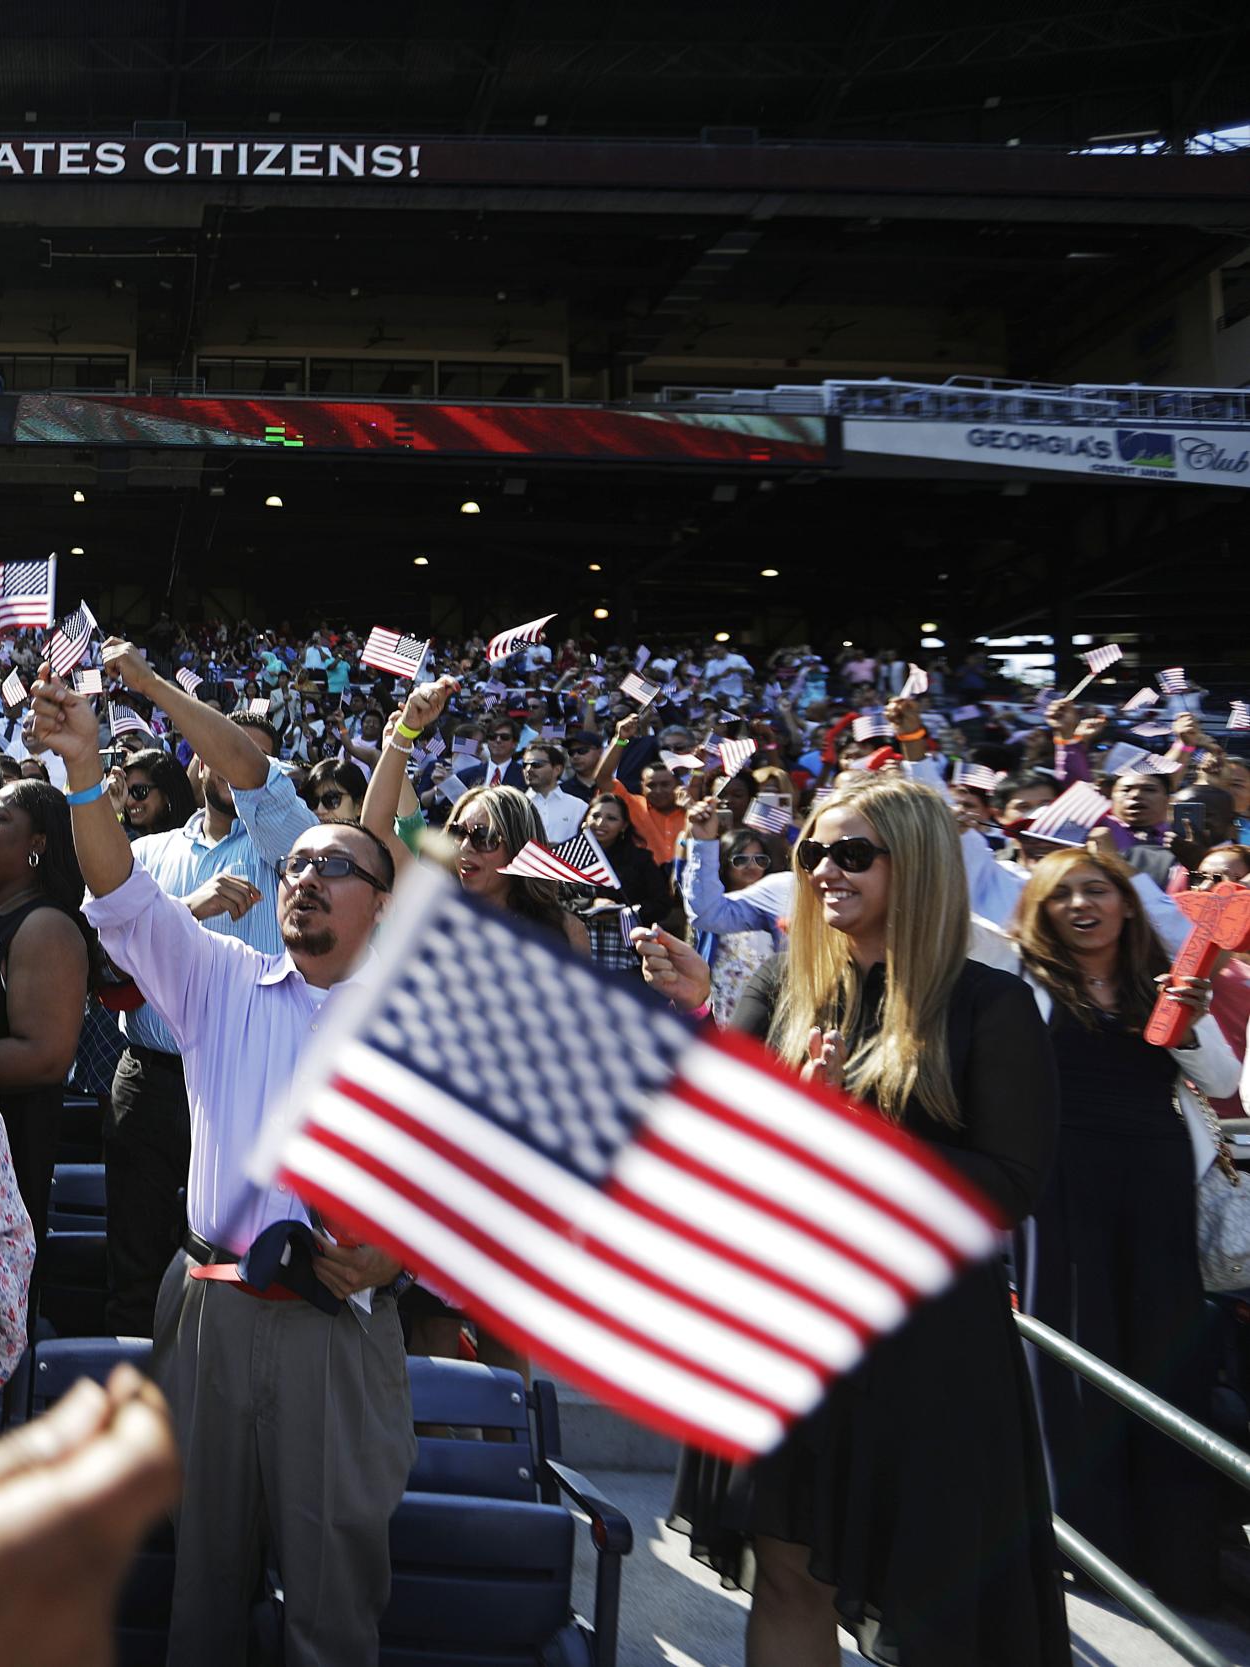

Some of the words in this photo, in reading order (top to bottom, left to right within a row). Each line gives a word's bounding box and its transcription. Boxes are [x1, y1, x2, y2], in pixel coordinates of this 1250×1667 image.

[142, 142, 421, 178] CITIZENS!
[967, 428, 1113, 460] GEORGIA'S
[1178, 437, 1250, 473] Club
